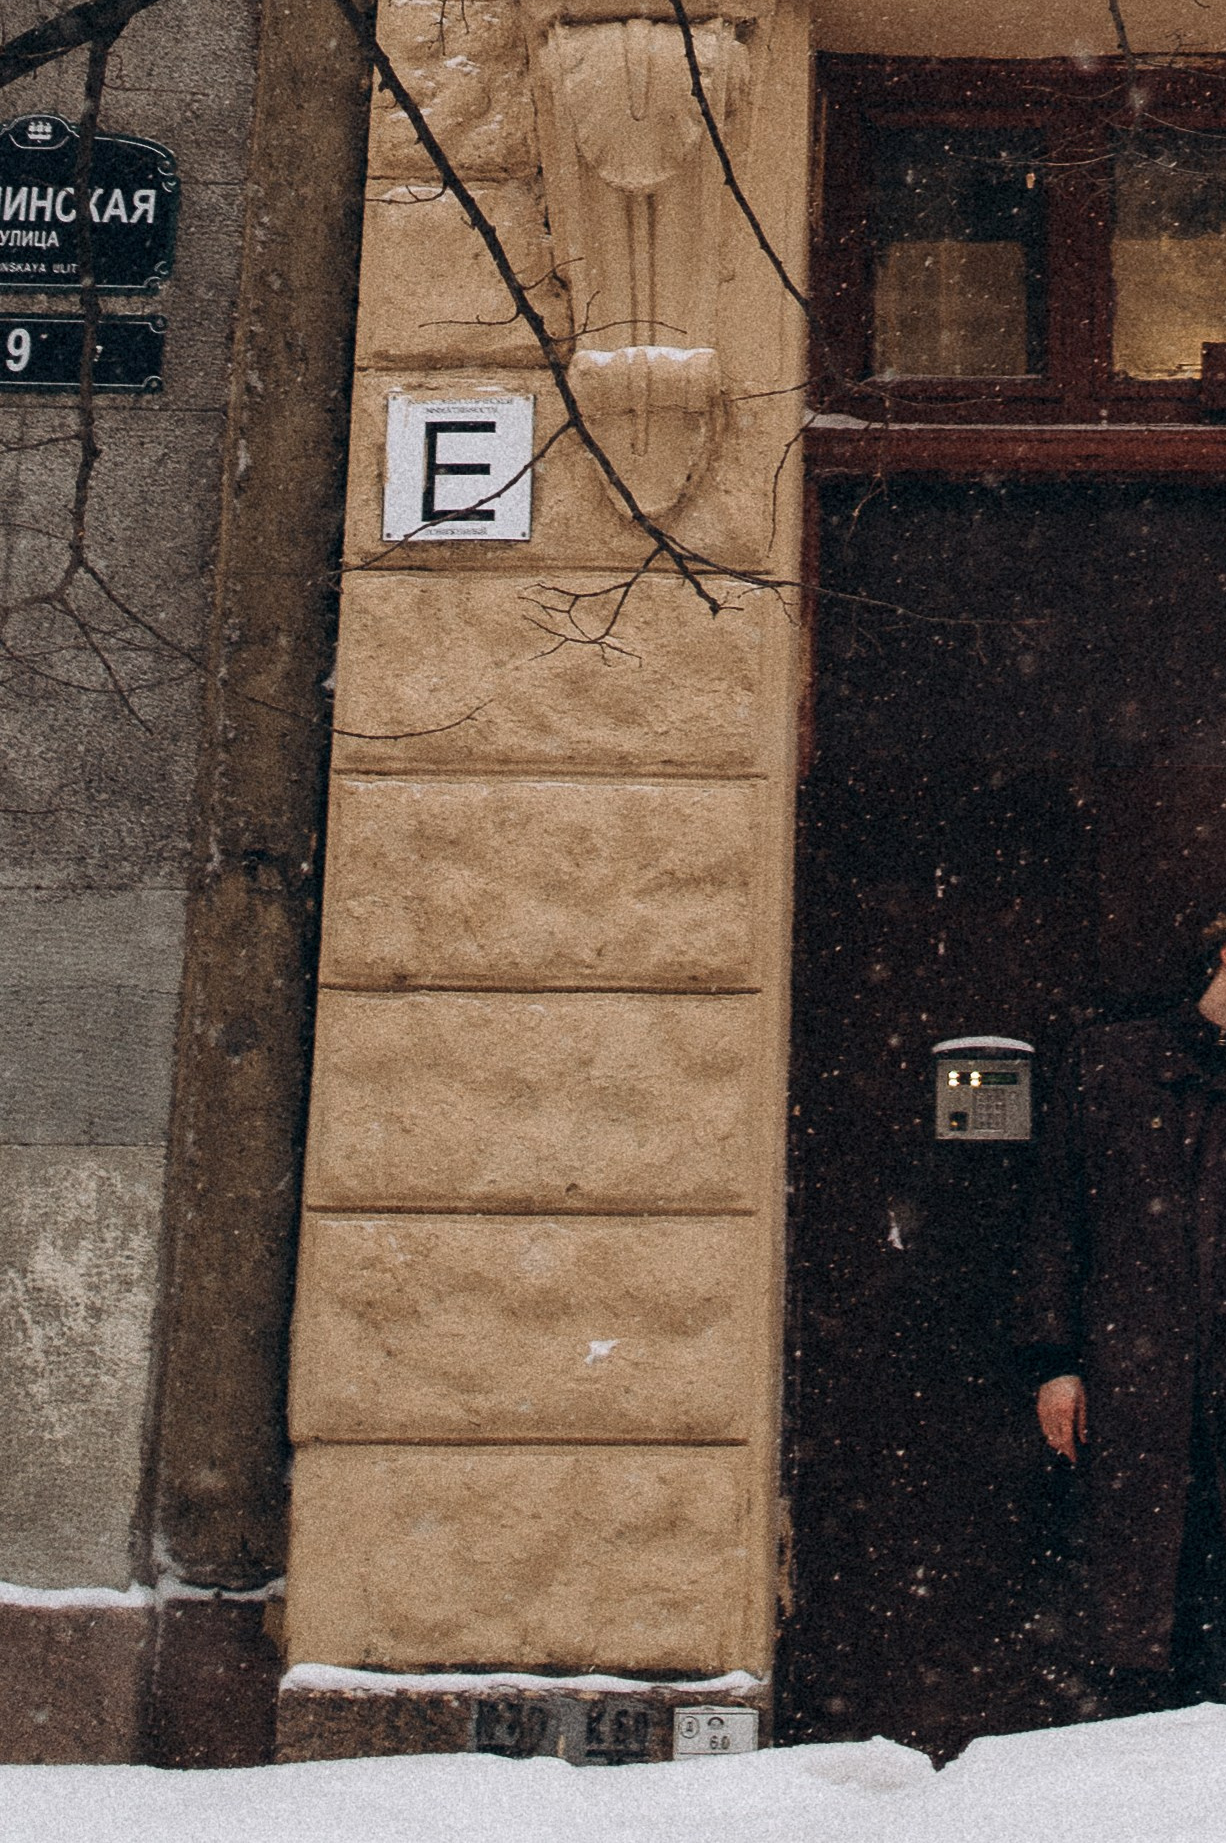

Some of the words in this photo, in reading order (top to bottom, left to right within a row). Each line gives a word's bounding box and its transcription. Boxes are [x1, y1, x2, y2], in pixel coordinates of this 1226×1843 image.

[0, 186, 156, 224] ИНСКАЯ
[0, 230, 60, 250] УЛИЦА
[6, 328, 32, 372] 9
